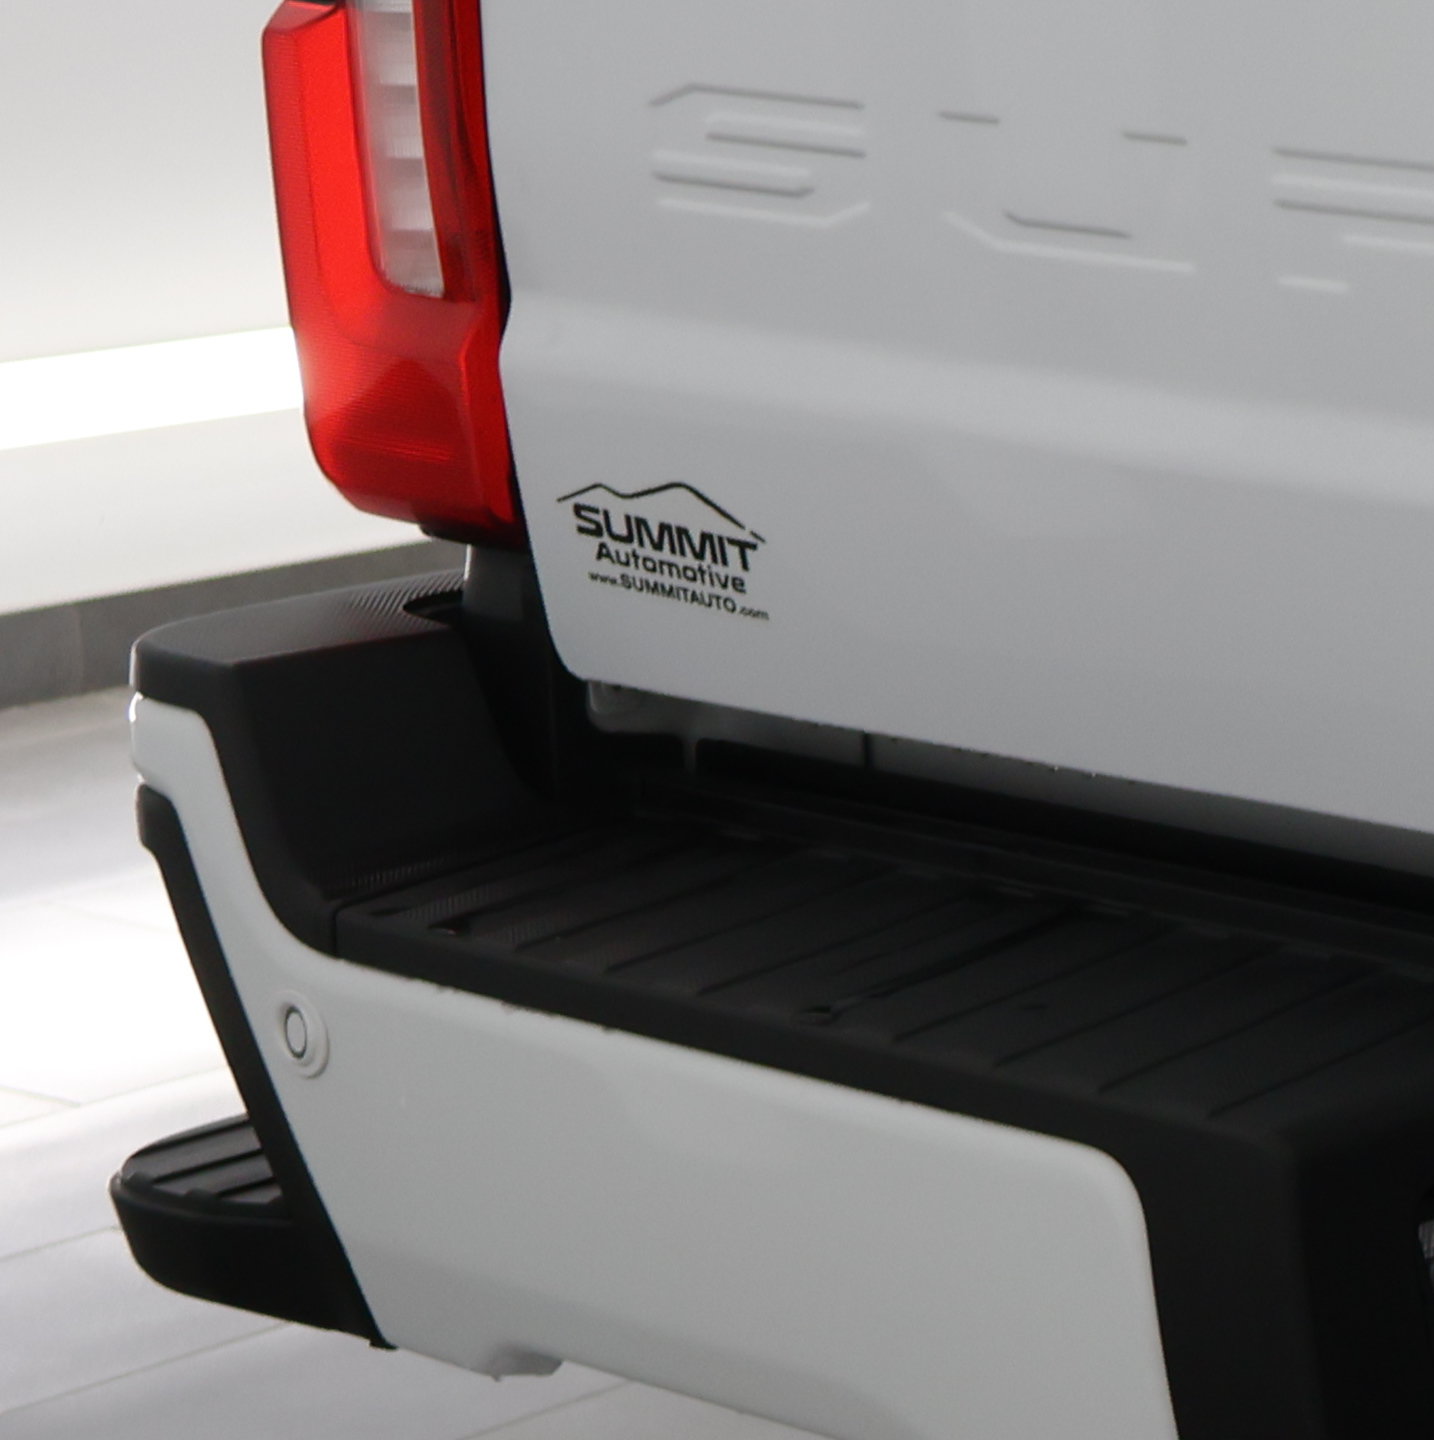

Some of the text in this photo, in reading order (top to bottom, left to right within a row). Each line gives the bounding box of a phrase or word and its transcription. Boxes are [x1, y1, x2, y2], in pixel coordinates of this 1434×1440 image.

[573, 503, 758, 571] SUMMIT
[595, 542, 747, 593] Automotive
[588, 572, 769, 620] www.SUMMITAUTO.com
